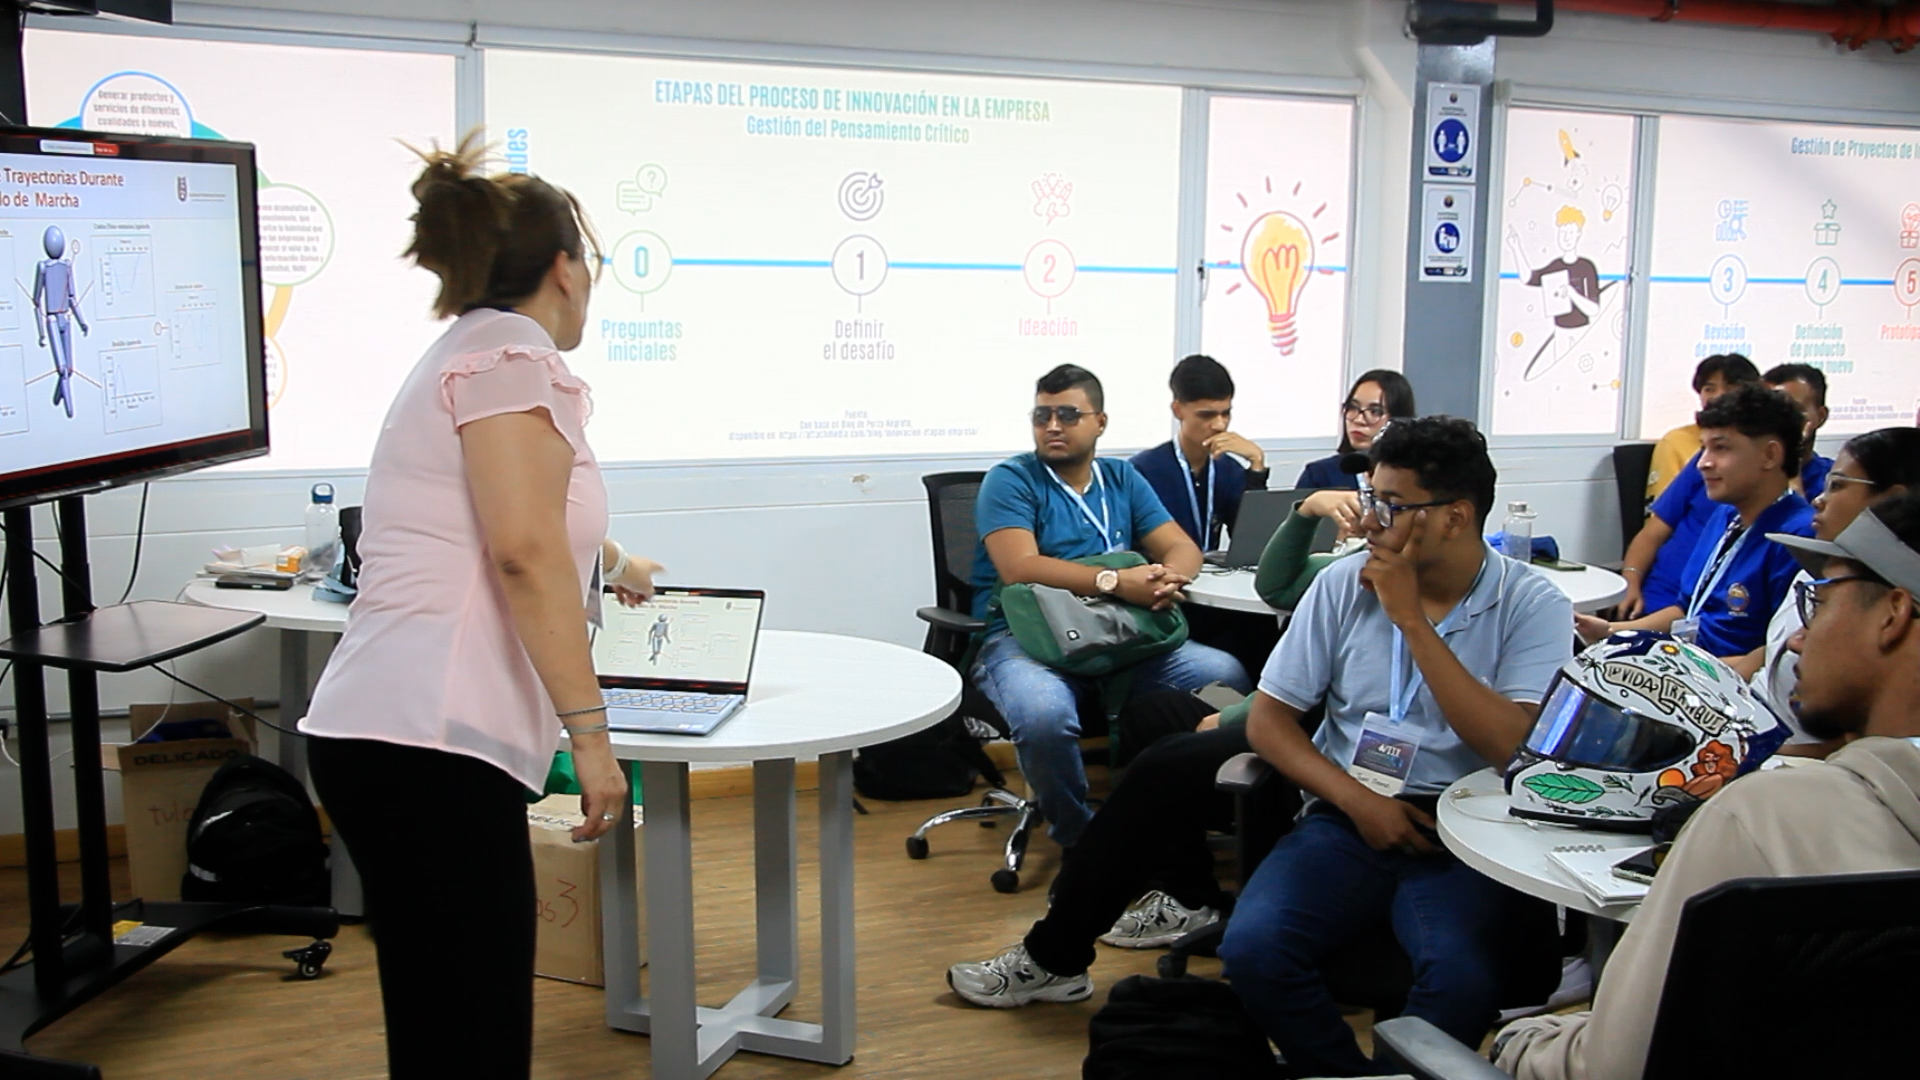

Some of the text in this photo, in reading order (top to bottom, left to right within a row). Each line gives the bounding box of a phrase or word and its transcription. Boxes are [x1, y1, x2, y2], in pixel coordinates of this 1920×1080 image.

[655, 80, 1051, 122] ETAPAS DEL PROCESO DE INNOVACIÓN EN LA EMPRESA
[746, 114, 970, 144] Gestión del Pensamiento Crítico
[1791, 136, 1830, 155] Gestión
[1832, 139, 1846, 156] de
[1847, 139, 1898, 159] Proyectos
[1899, 142, 1912, 159] de
[3, 168, 124, 187] Trayectorias Durante
[13, 191, 29, 207] de
[35, 192, 80, 208] Marcha
[634, 245, 650, 278] 0
[856, 249, 865, 281] 1
[1043, 254, 1057, 284] 2
[1723, 266, 1735, 292] 3
[1818, 268, 1828, 293] 4
[1906, 269, 1917, 294] 5
[601, 318, 683, 342] Preguntas
[834, 318, 884, 339] Definir
[1018, 316, 1078, 337] Ideación
[1704, 322, 1746, 340] Revisión
[1795, 322, 1843, 340] Definición
[607, 340, 677, 361] iniciales
[823, 339, 895, 361] el desafío
[1695, 342, 1752, 358] de mercado
[1790, 343, 1846, 358] de producto
[1622, 669, 1659, 693] VIDA
[133, 748, 239, 767] DELICADO
[557, 878, 580, 929] 3
